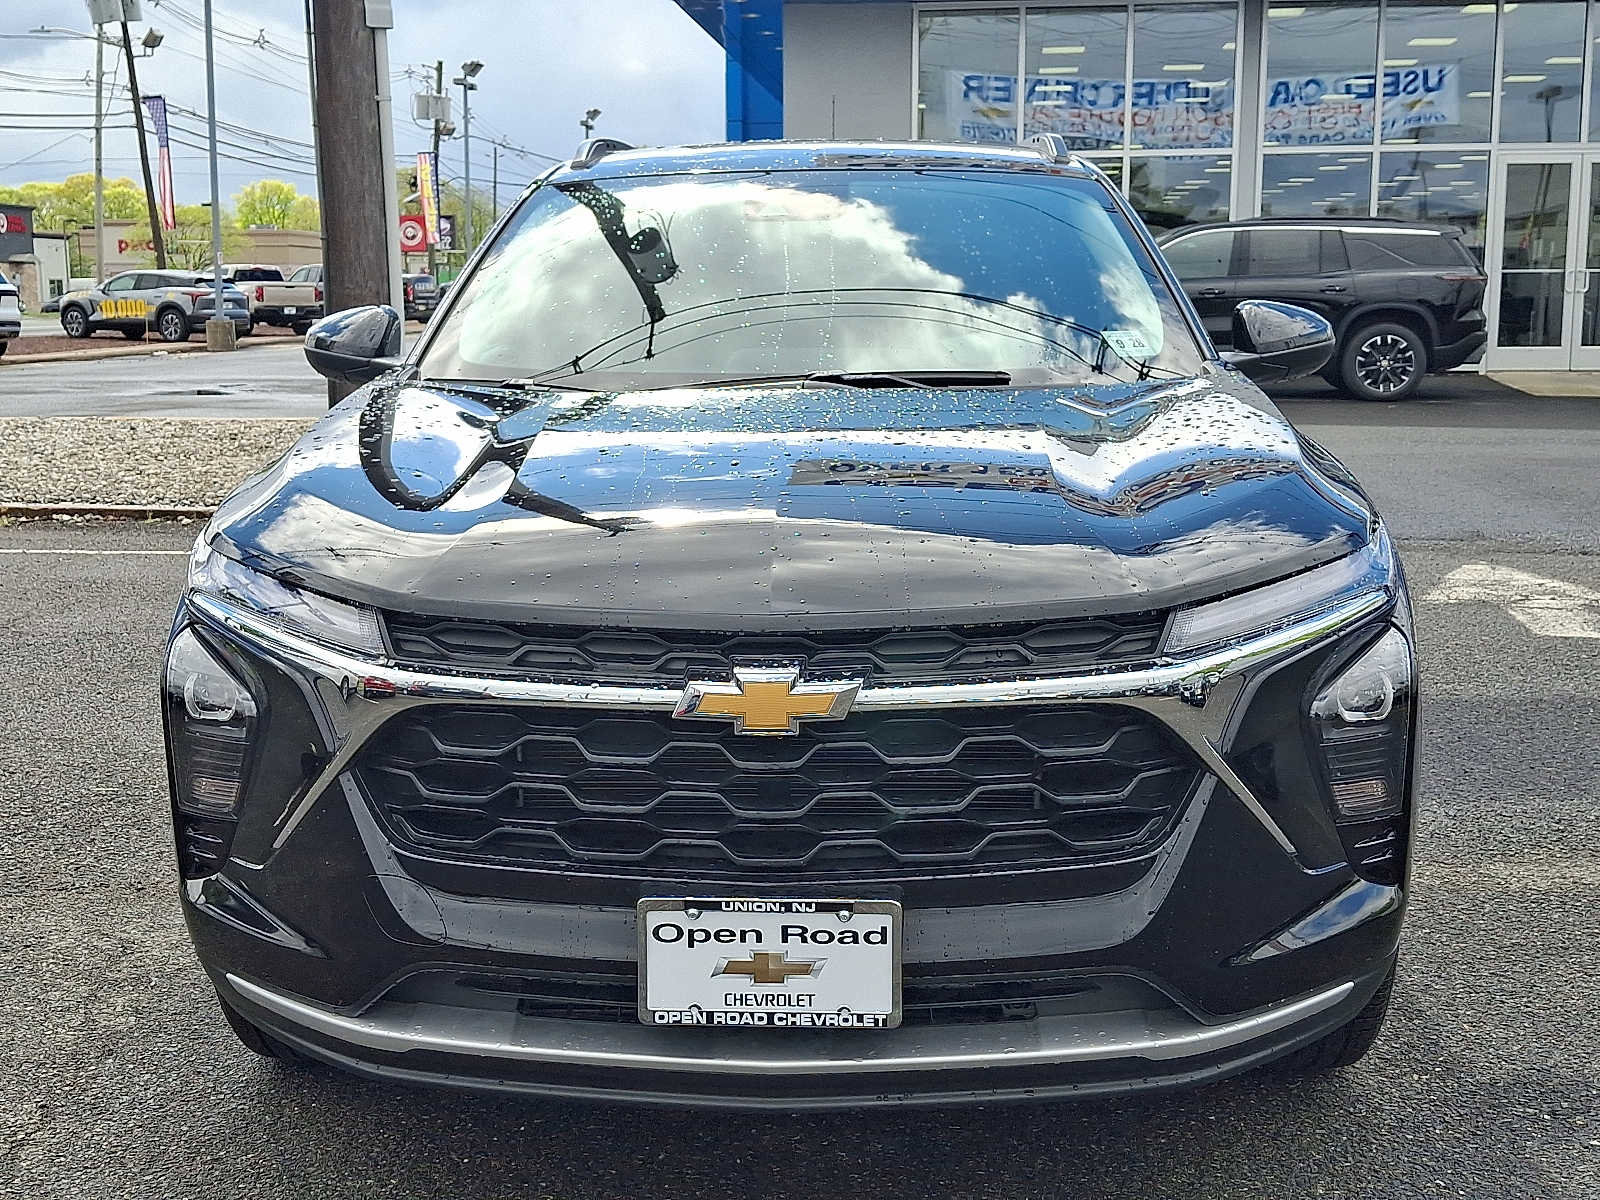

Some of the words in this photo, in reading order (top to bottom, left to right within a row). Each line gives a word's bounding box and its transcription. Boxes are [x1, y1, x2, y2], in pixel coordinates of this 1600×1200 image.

[721, 900, 785, 914] UNION,
[791, 902, 816, 913] NJ
[651, 922, 764, 949] Open
[780, 924, 888, 945] Road
[723, 992, 816, 1007] CHEVROLET
[654, 1010, 707, 1025] OPEN
[713, 1012, 768, 1026] ROAD
[773, 1012, 887, 1028] CHEVROLET
